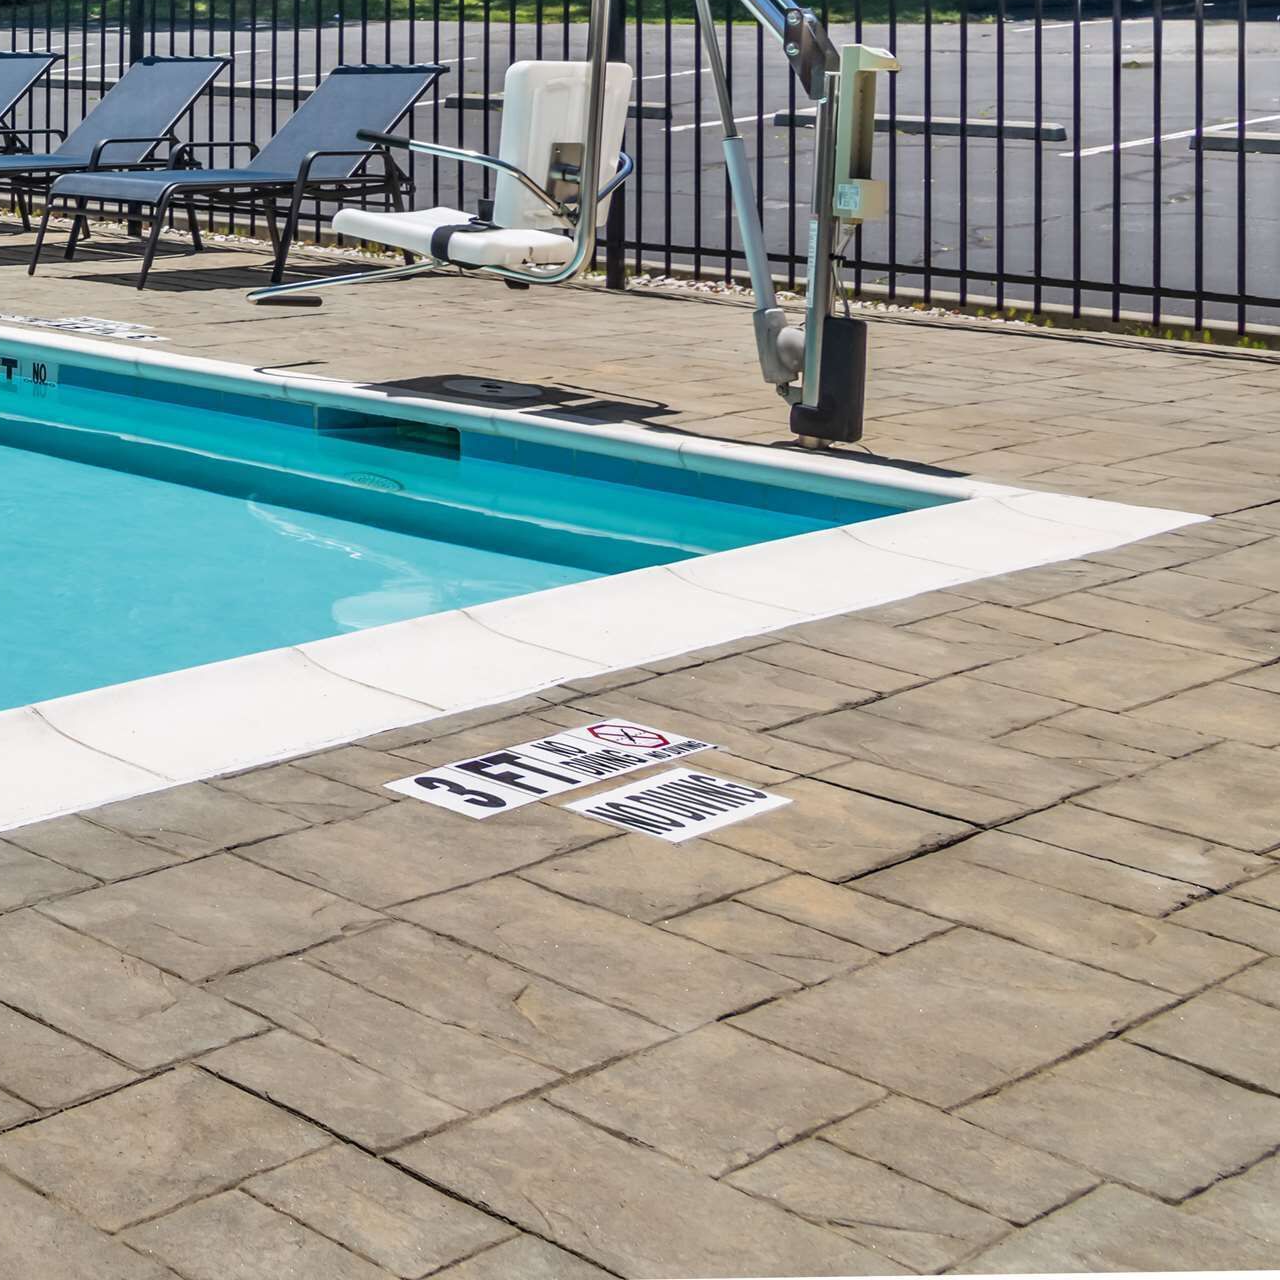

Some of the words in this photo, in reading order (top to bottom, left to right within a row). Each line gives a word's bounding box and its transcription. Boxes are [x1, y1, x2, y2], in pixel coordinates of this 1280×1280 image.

[32, 362, 47, 385] NO
[530, 740, 583, 759] NO
[562, 749, 648, 776] DIVING
[648, 749, 673, 761] NO
[669, 740, 708, 756] DIVING
[454, 752, 582, 795] FT
[414, 776, 507, 809] 3
[585, 800, 687, 835] NO
[640, 773, 768, 822] DIVING
